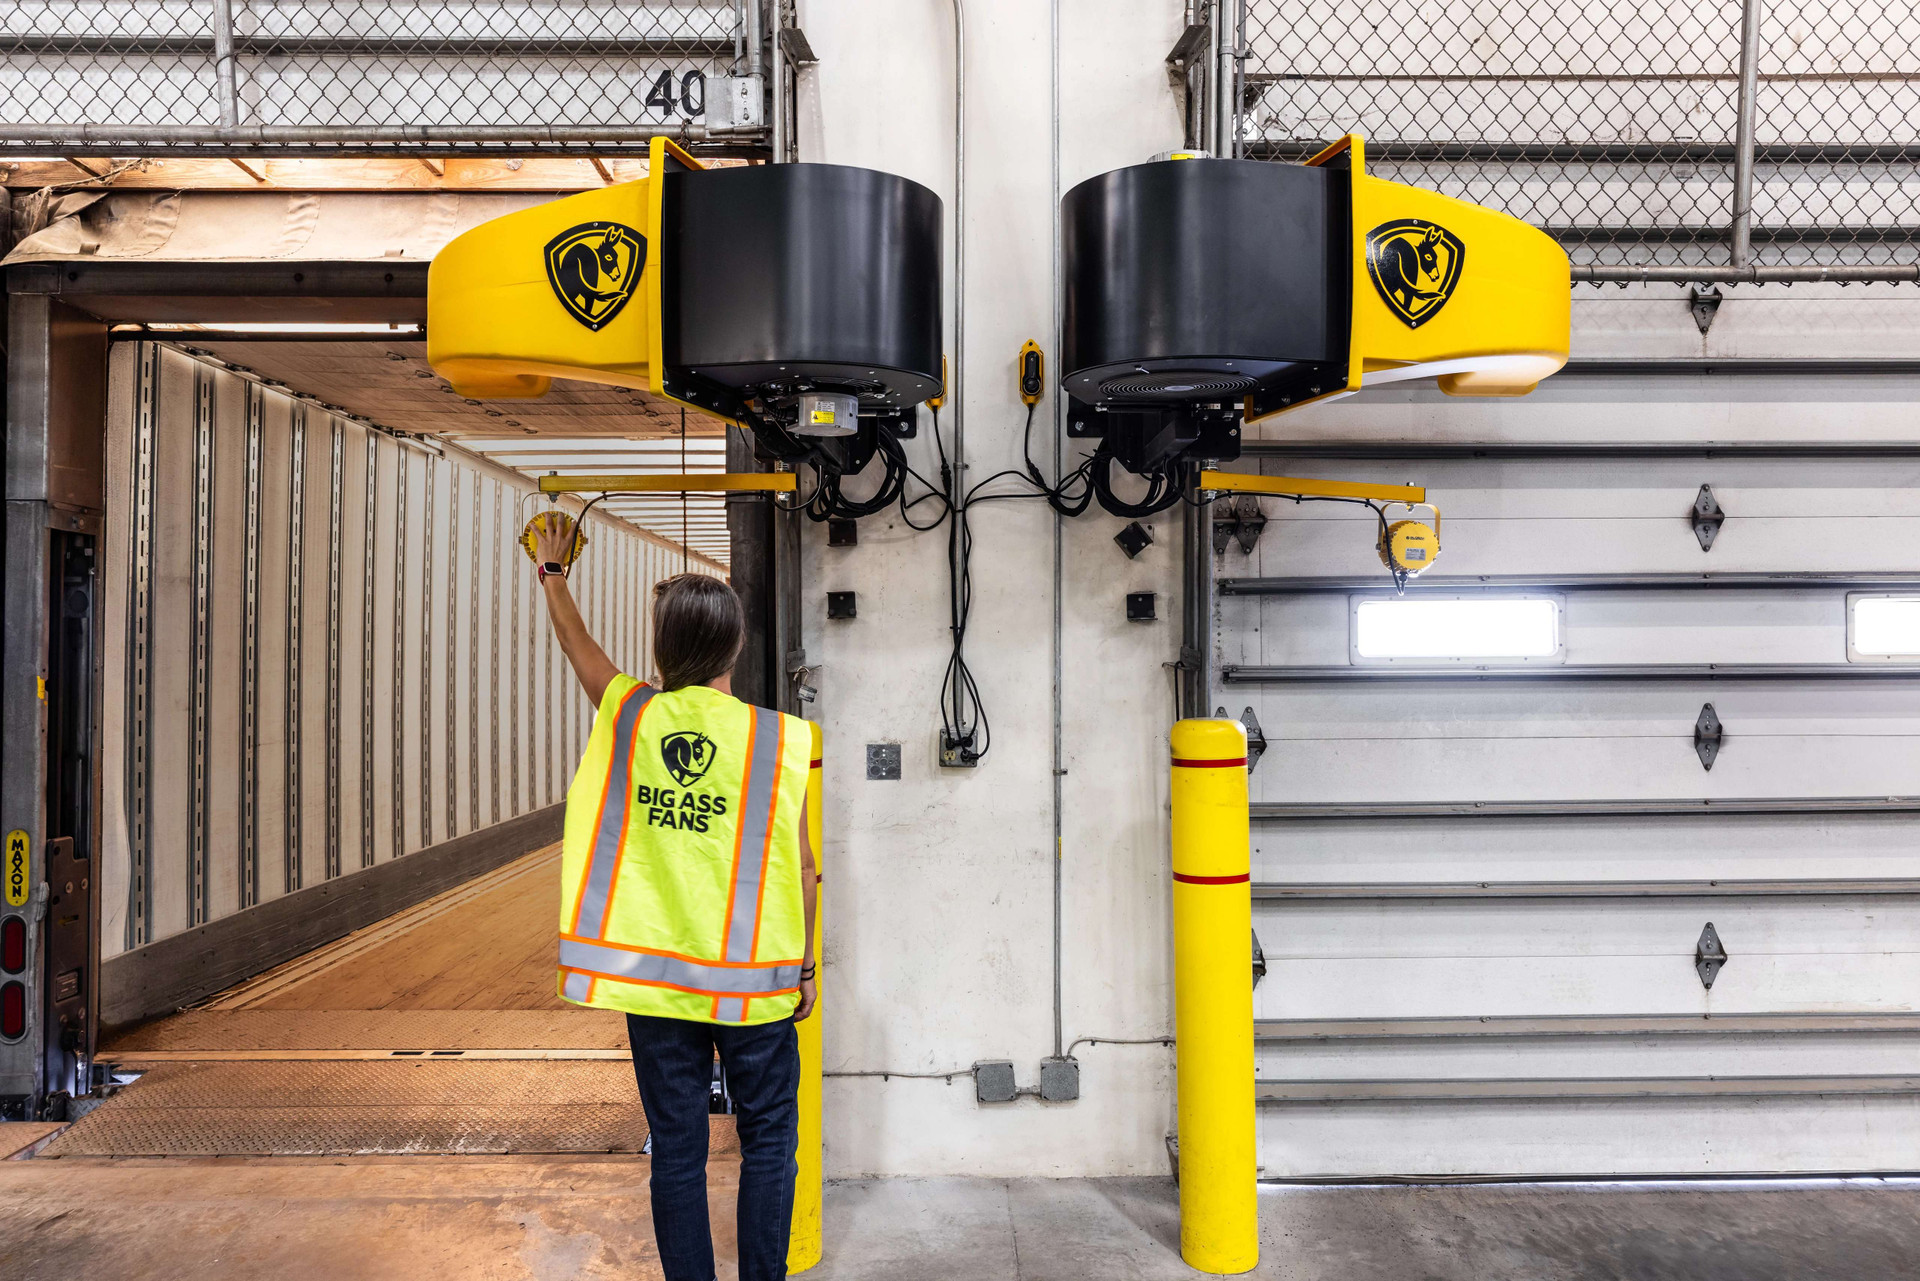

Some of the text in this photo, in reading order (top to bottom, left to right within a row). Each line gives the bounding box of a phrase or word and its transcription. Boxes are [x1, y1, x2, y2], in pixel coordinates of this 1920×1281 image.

[645, 69, 706, 117] 40
[637, 784, 727, 816] BIG ASS
[648, 806, 709, 833] FANS
[11, 838, 25, 898] MAXON
